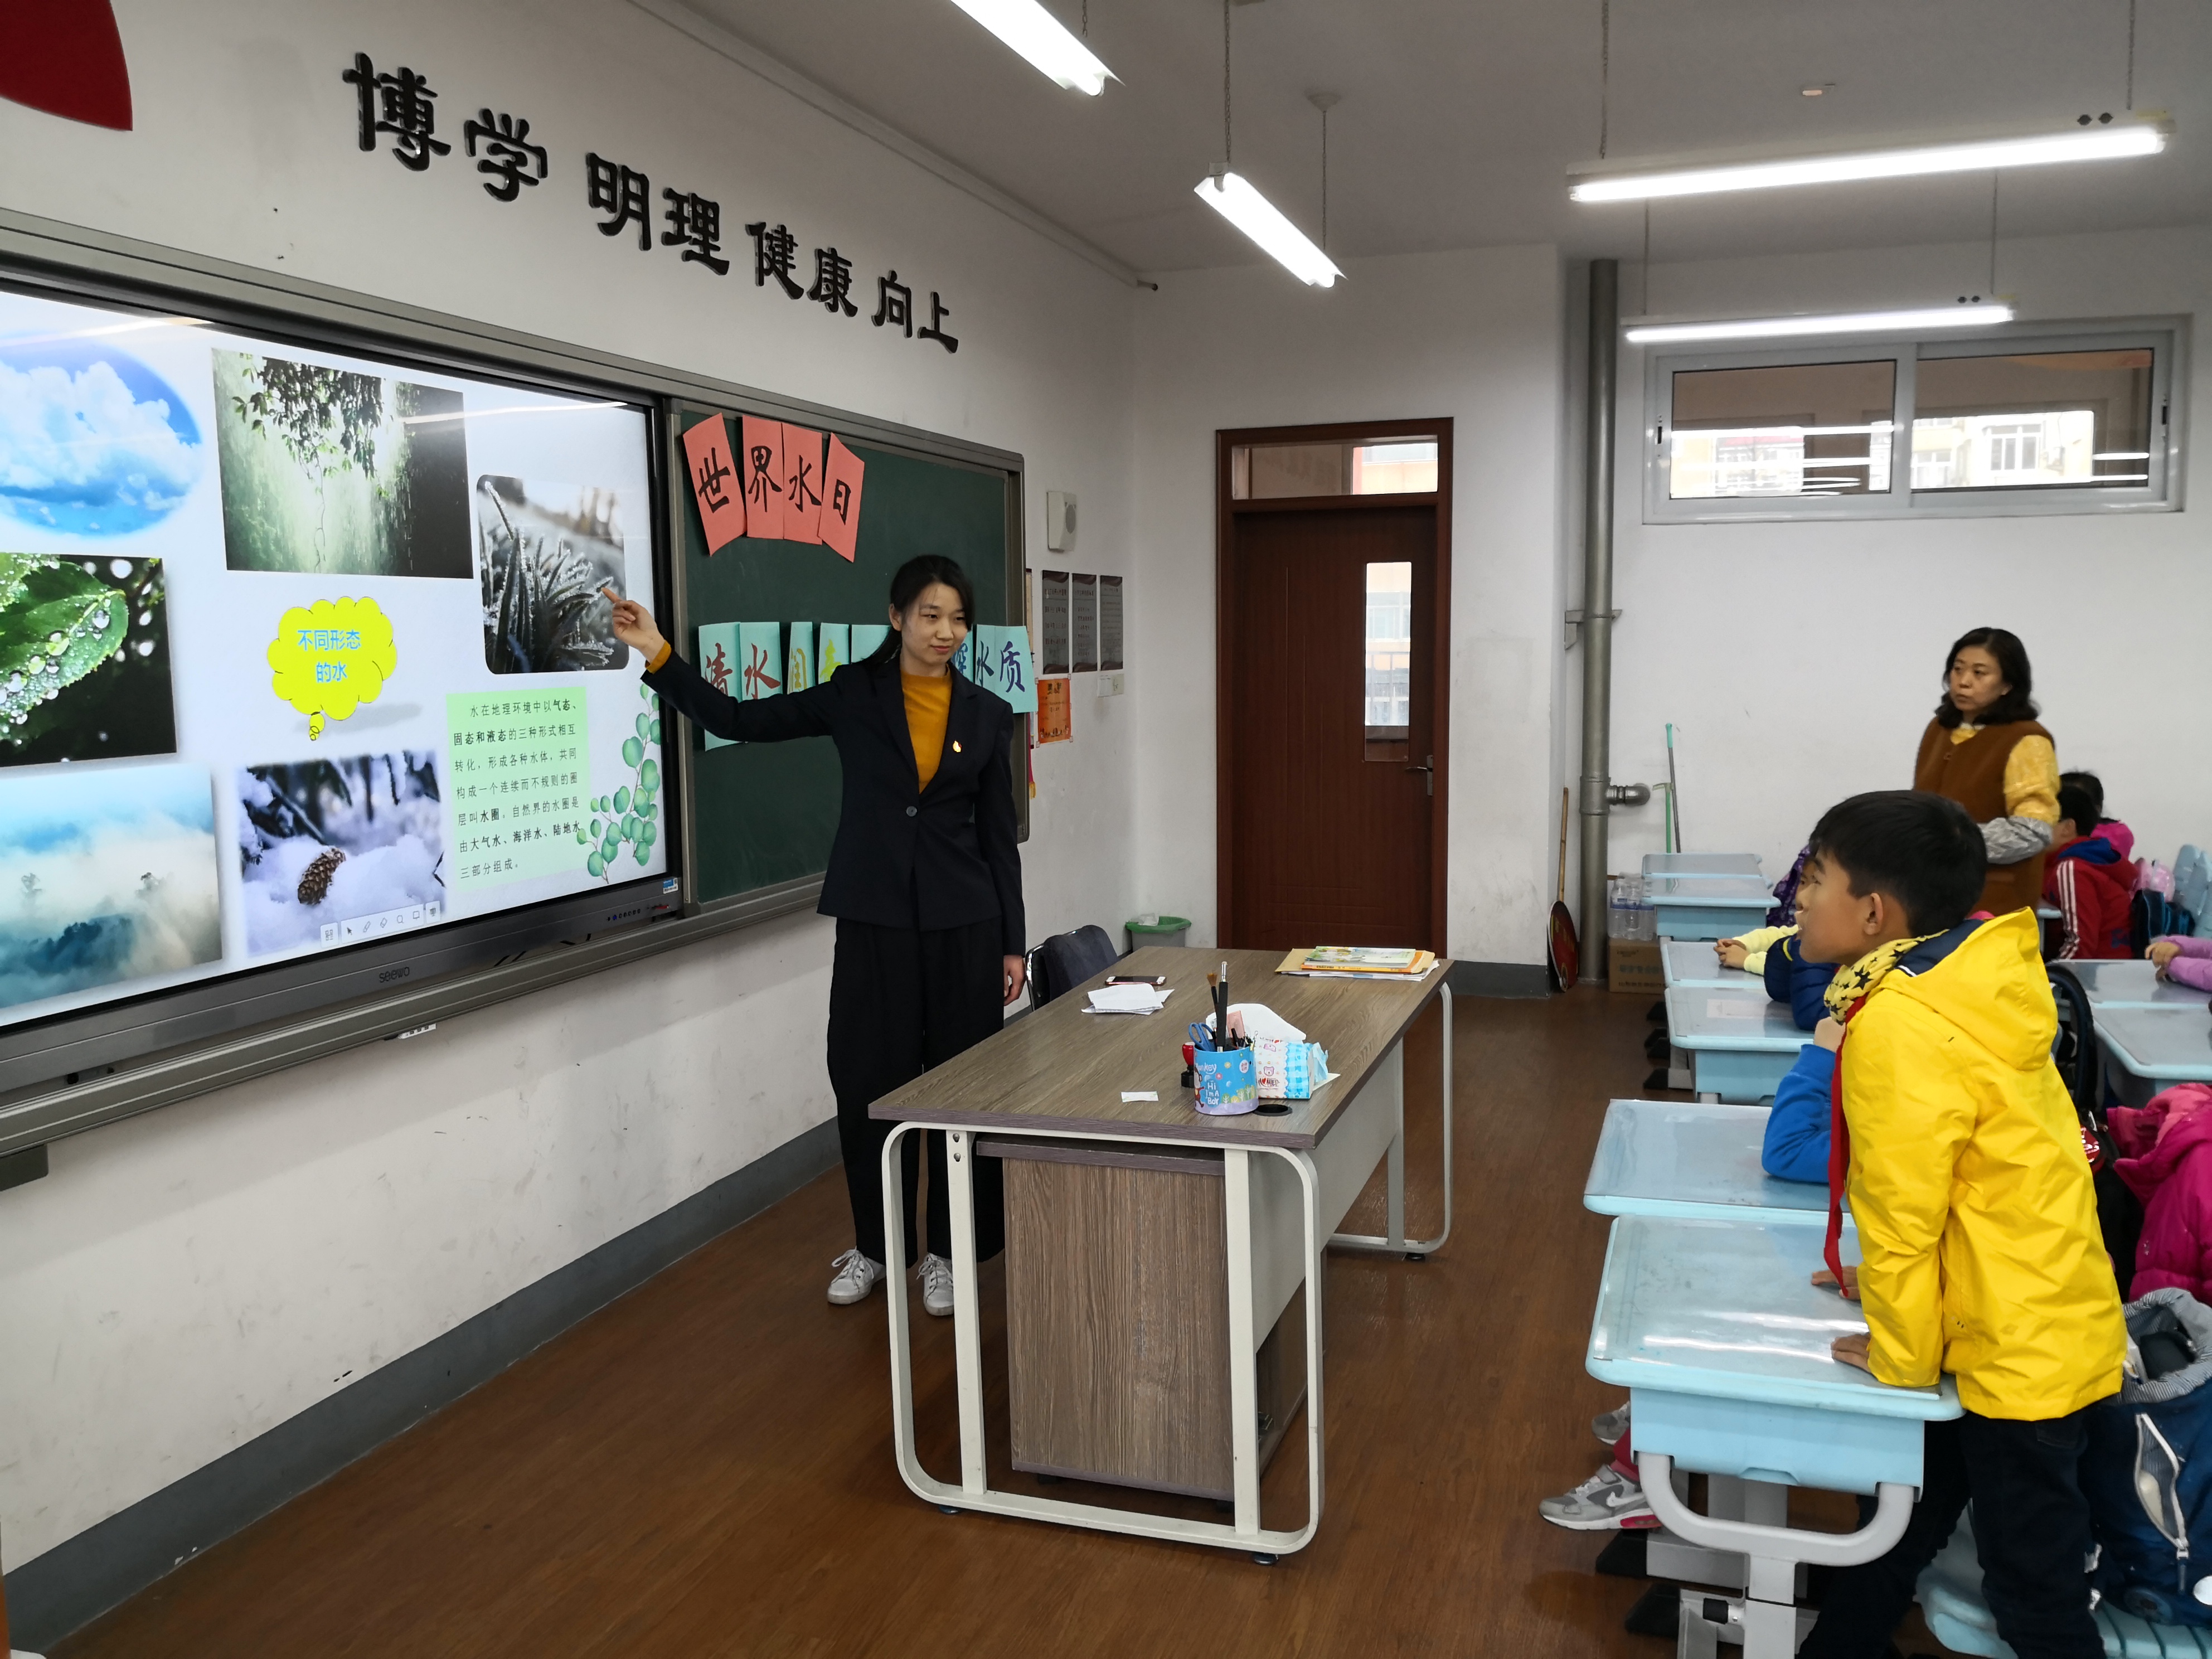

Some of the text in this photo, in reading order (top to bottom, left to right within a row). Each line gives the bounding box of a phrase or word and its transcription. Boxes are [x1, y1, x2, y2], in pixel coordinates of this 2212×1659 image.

[342, 51, 959, 354] 博学 明理 健康 向上
[698, 445, 852, 526] 世界水日
[297, 629, 361, 651] 不同形态
[316, 661, 347, 683] 的水
[470, 698, 576, 717] 水在地理环境中以气态、
[454, 724, 576, 746] 固态和液态的三种形式相互
[456, 772, 578, 800] 构成一个连续而不规则的圈
[460, 858, 518, 879] 三部分组成。
[379, 967, 410, 983] seewo
